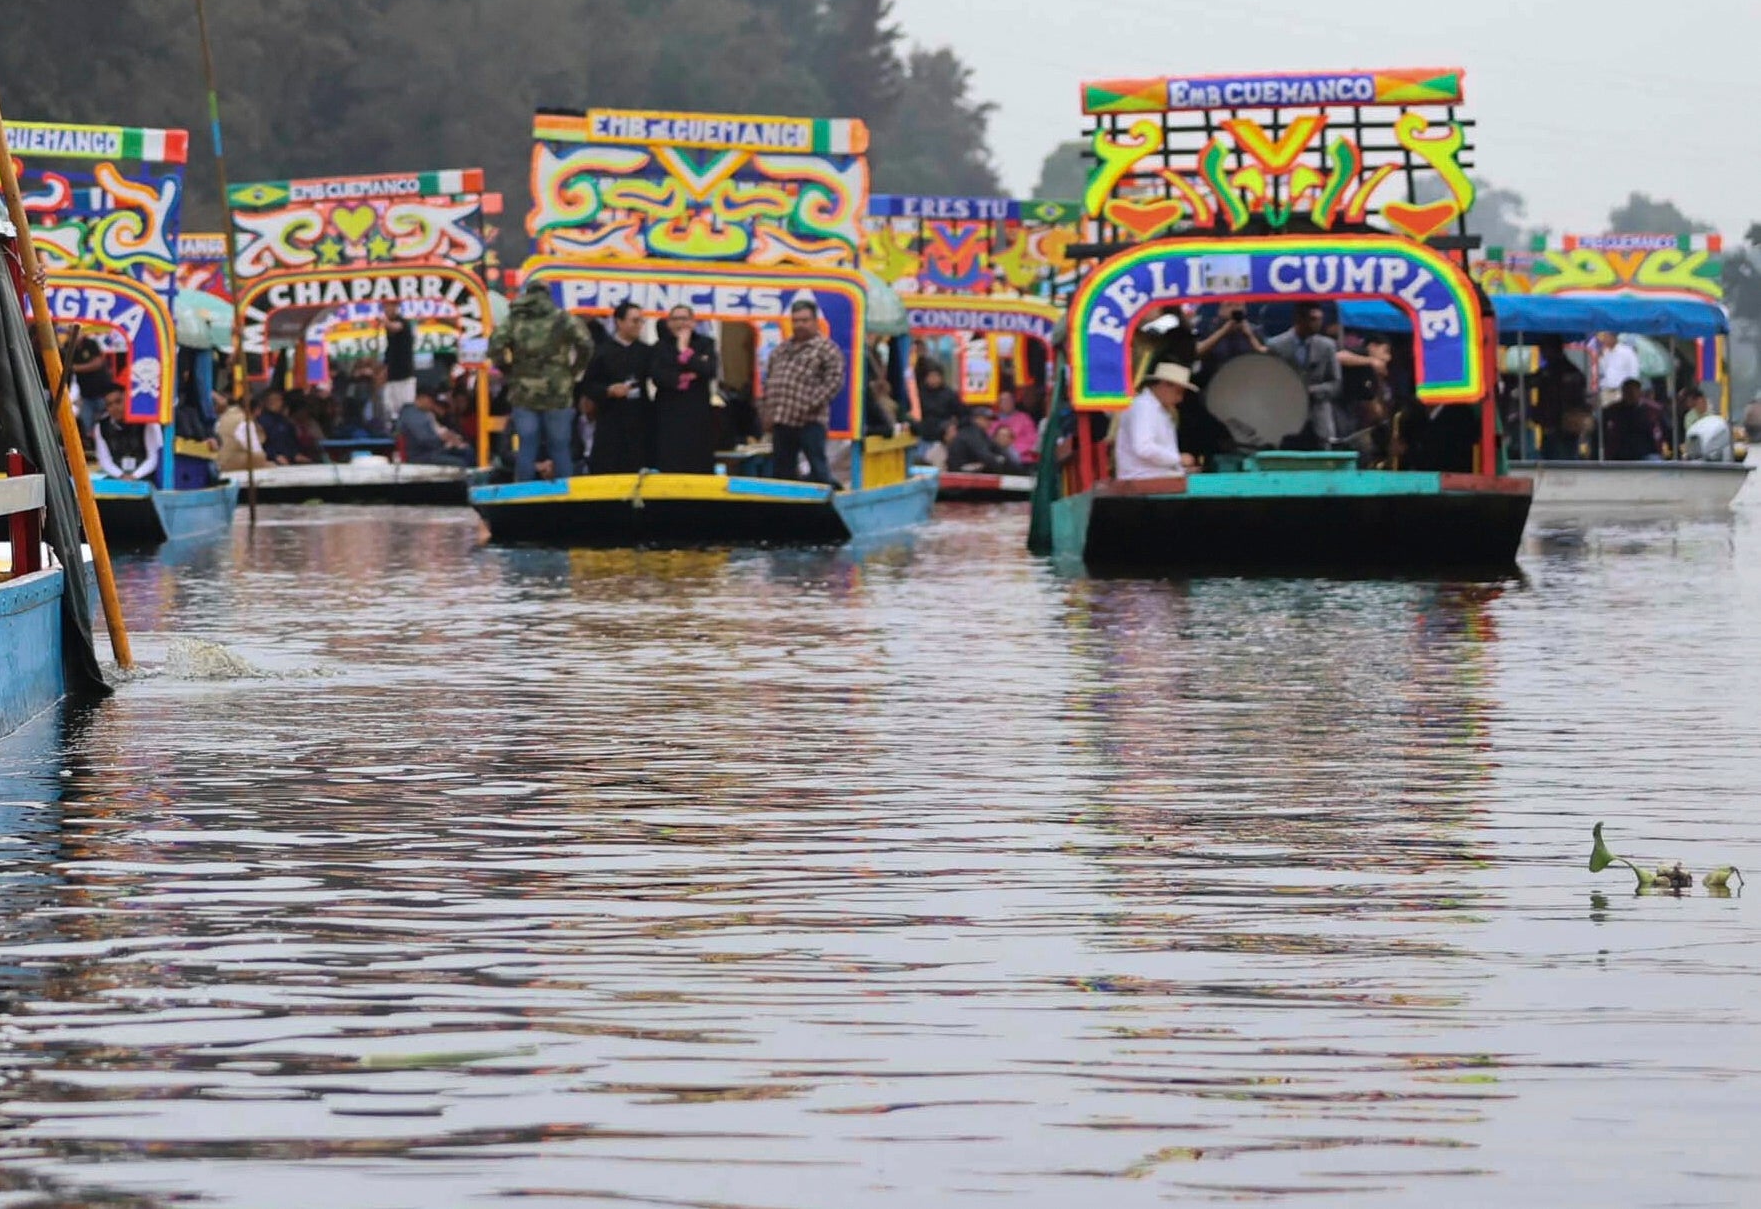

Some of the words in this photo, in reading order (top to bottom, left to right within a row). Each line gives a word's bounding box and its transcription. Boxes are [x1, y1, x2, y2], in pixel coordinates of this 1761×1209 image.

[1224, 76, 1374, 105] CUEMANCO
[594, 115, 646, 138] EMB
[674, 120, 809, 148] CUEMANCO
[902, 196, 971, 218] ERES
[976, 198, 1009, 219] TU
[240, 305, 272, 354] MI
[267, 275, 484, 339] CHAPARRITA
[1087, 258, 1206, 345] FELI
[1268, 255, 1461, 340] CUMPLE
